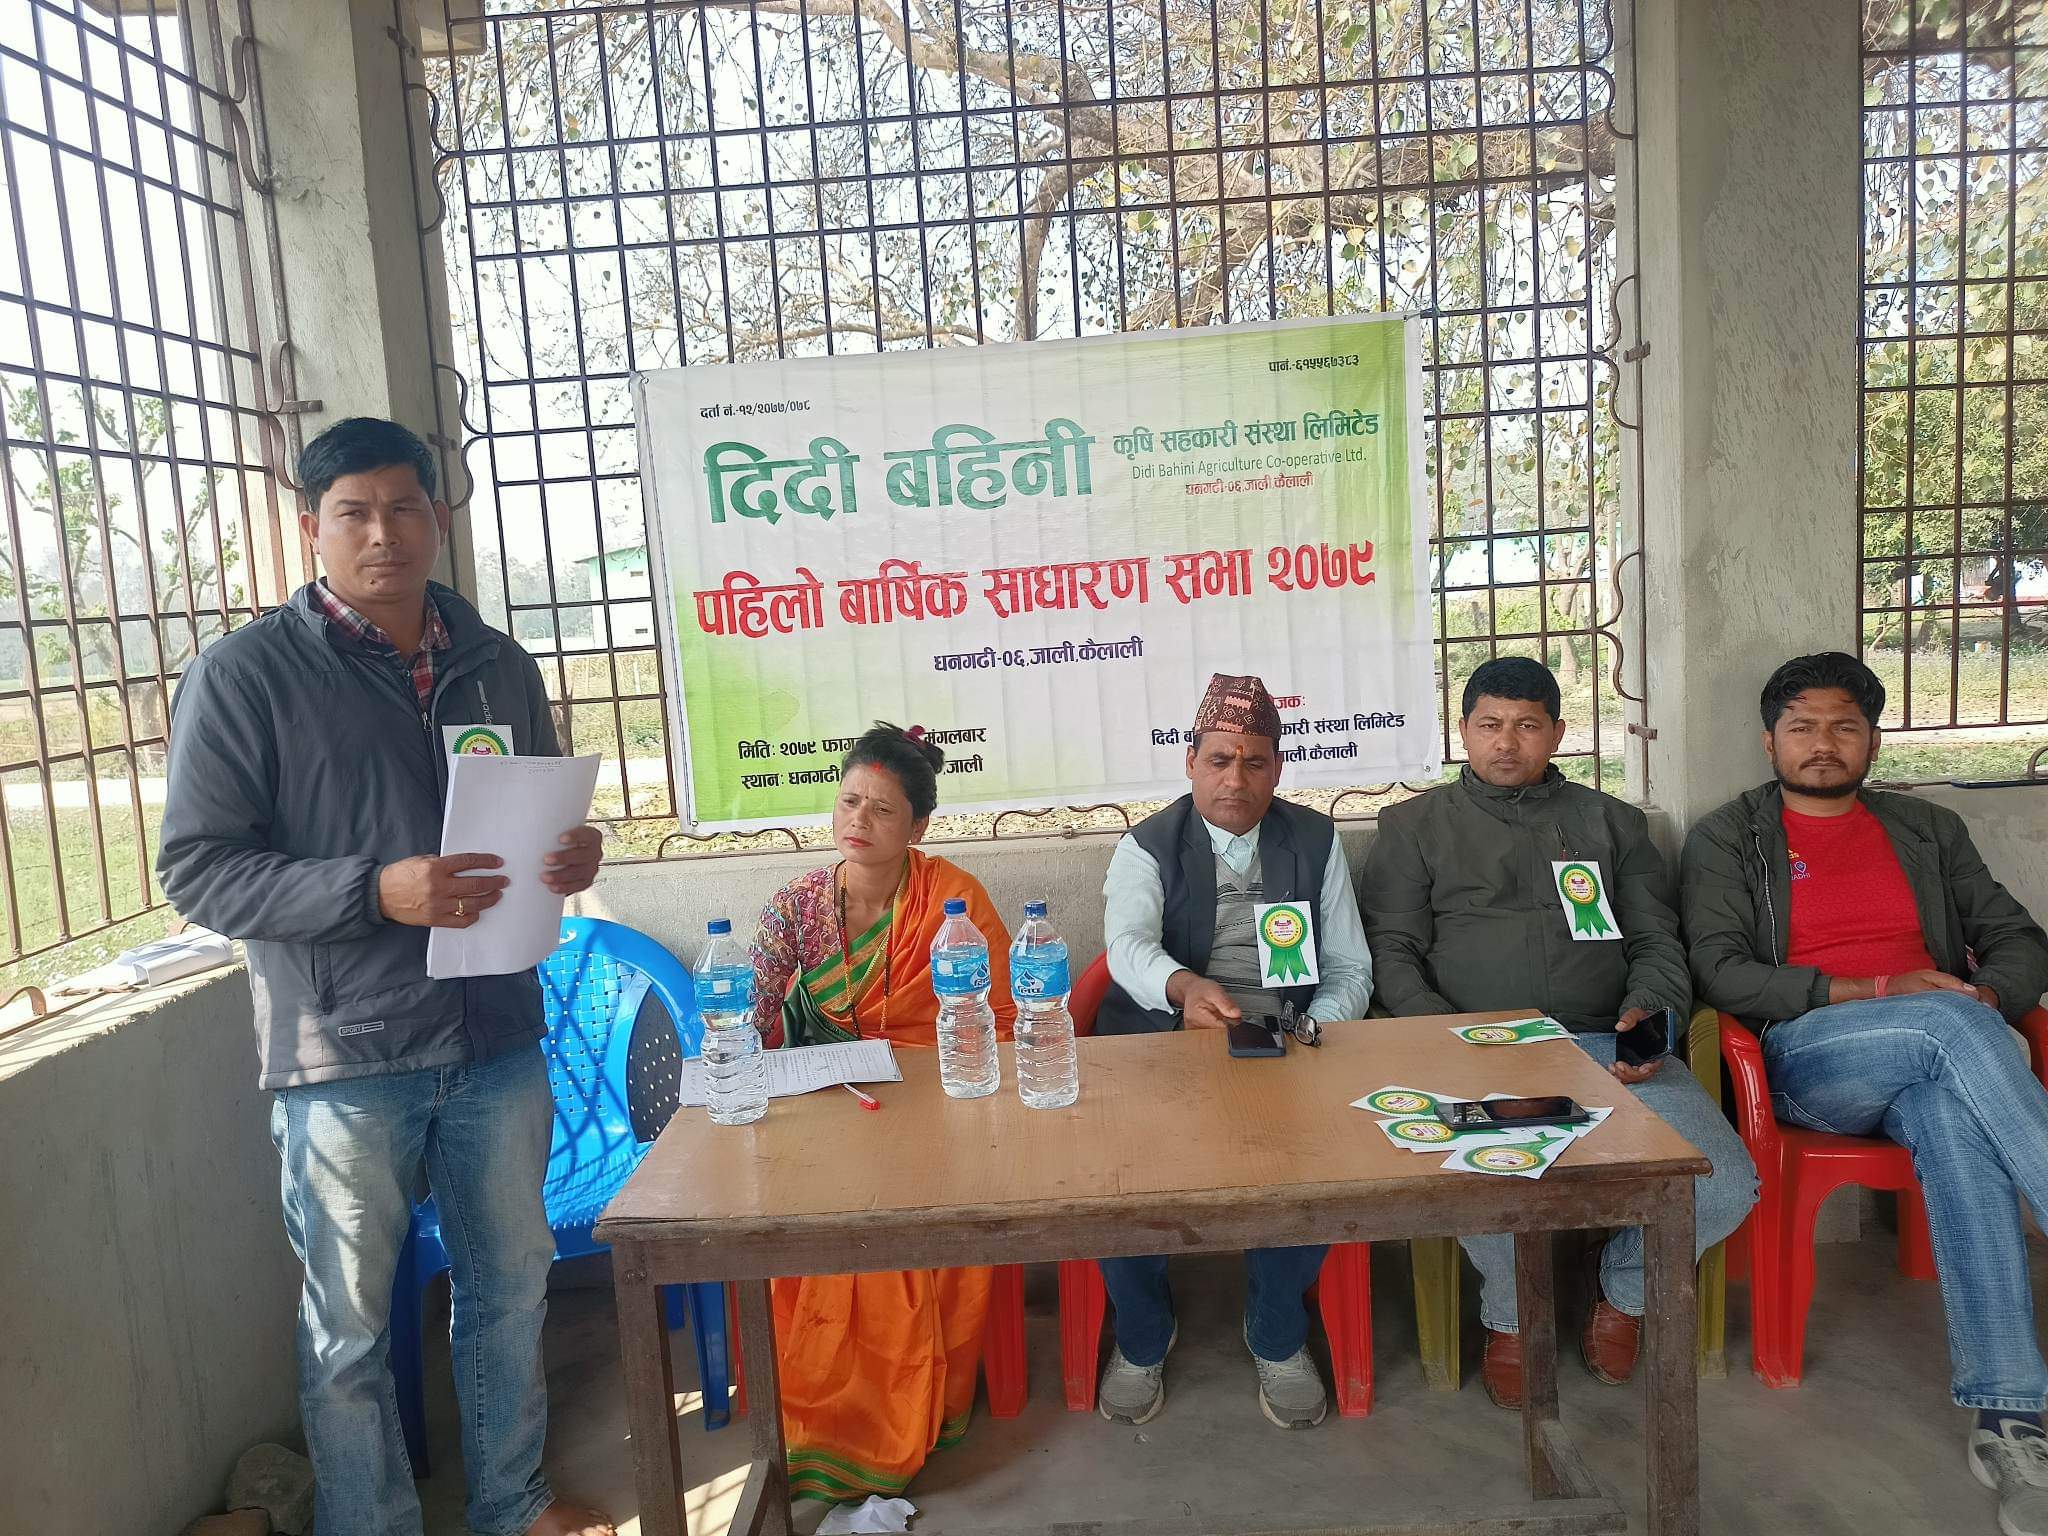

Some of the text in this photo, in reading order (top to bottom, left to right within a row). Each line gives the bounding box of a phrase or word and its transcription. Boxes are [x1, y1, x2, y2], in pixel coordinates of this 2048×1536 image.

[699, 403, 720, 419] दर्ता
[1113, 408, 1379, 460] कृषि सहकारी संस्था लिमिटेड
[703, 417, 1096, 526] दिदी बहिनी
[1132, 447, 1367, 480] Didi Bahini Agriculture Co-operative Ltd.
[694, 539, 1377, 639] पहिलो बार्षिक साधारण सभा २०७९
[1151, 727, 1181, 746] दिदी
[1280, 718, 1310, 735] कारी
[1313, 718, 1350, 734] संस्था
[1353, 711, 1406, 731] लिमिटेड
[779, 741, 816, 756] २०७९
